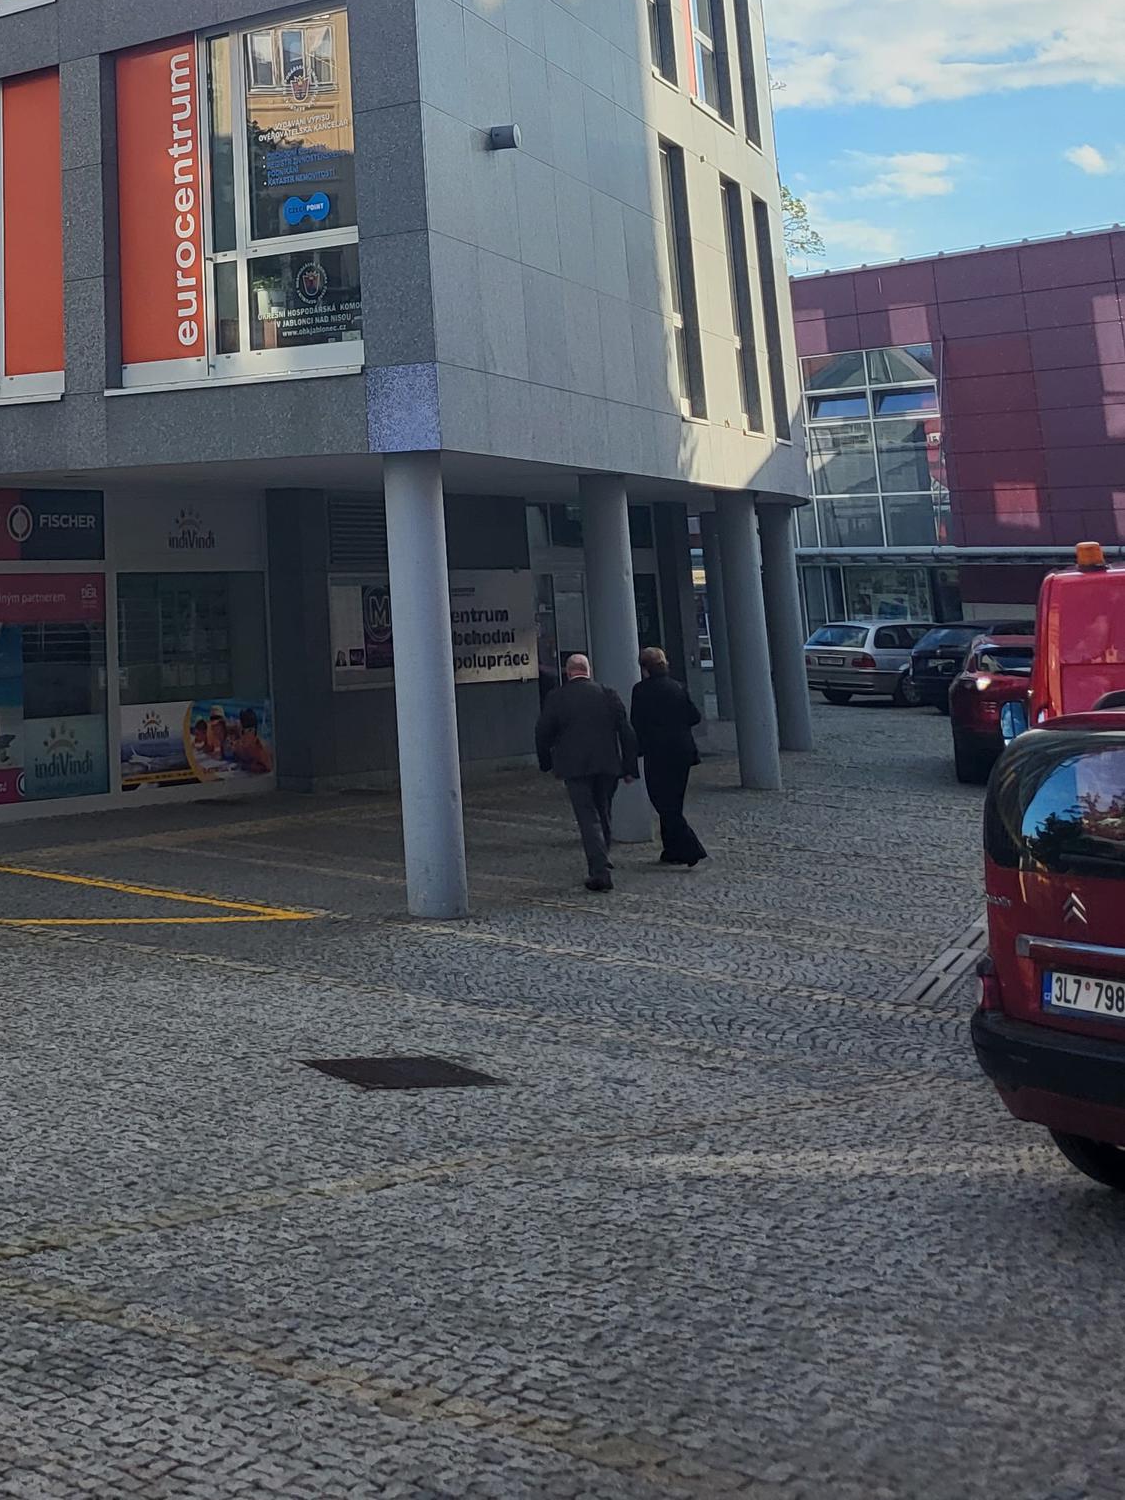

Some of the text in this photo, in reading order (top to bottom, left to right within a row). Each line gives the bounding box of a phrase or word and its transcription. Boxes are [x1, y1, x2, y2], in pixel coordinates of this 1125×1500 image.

[168, 51, 199, 347] eurocentrum
[282, 316, 314, 327] JABLONCI
[315, 315, 329, 324] NAD
[39, 514, 96, 528] FISCHER
[168, 529, 216, 549] indiVindi
[452, 608, 509, 623] entrum
[34, 750, 94, 779] indiVindi
[1055, 976, 1082, 1005] 3L7
